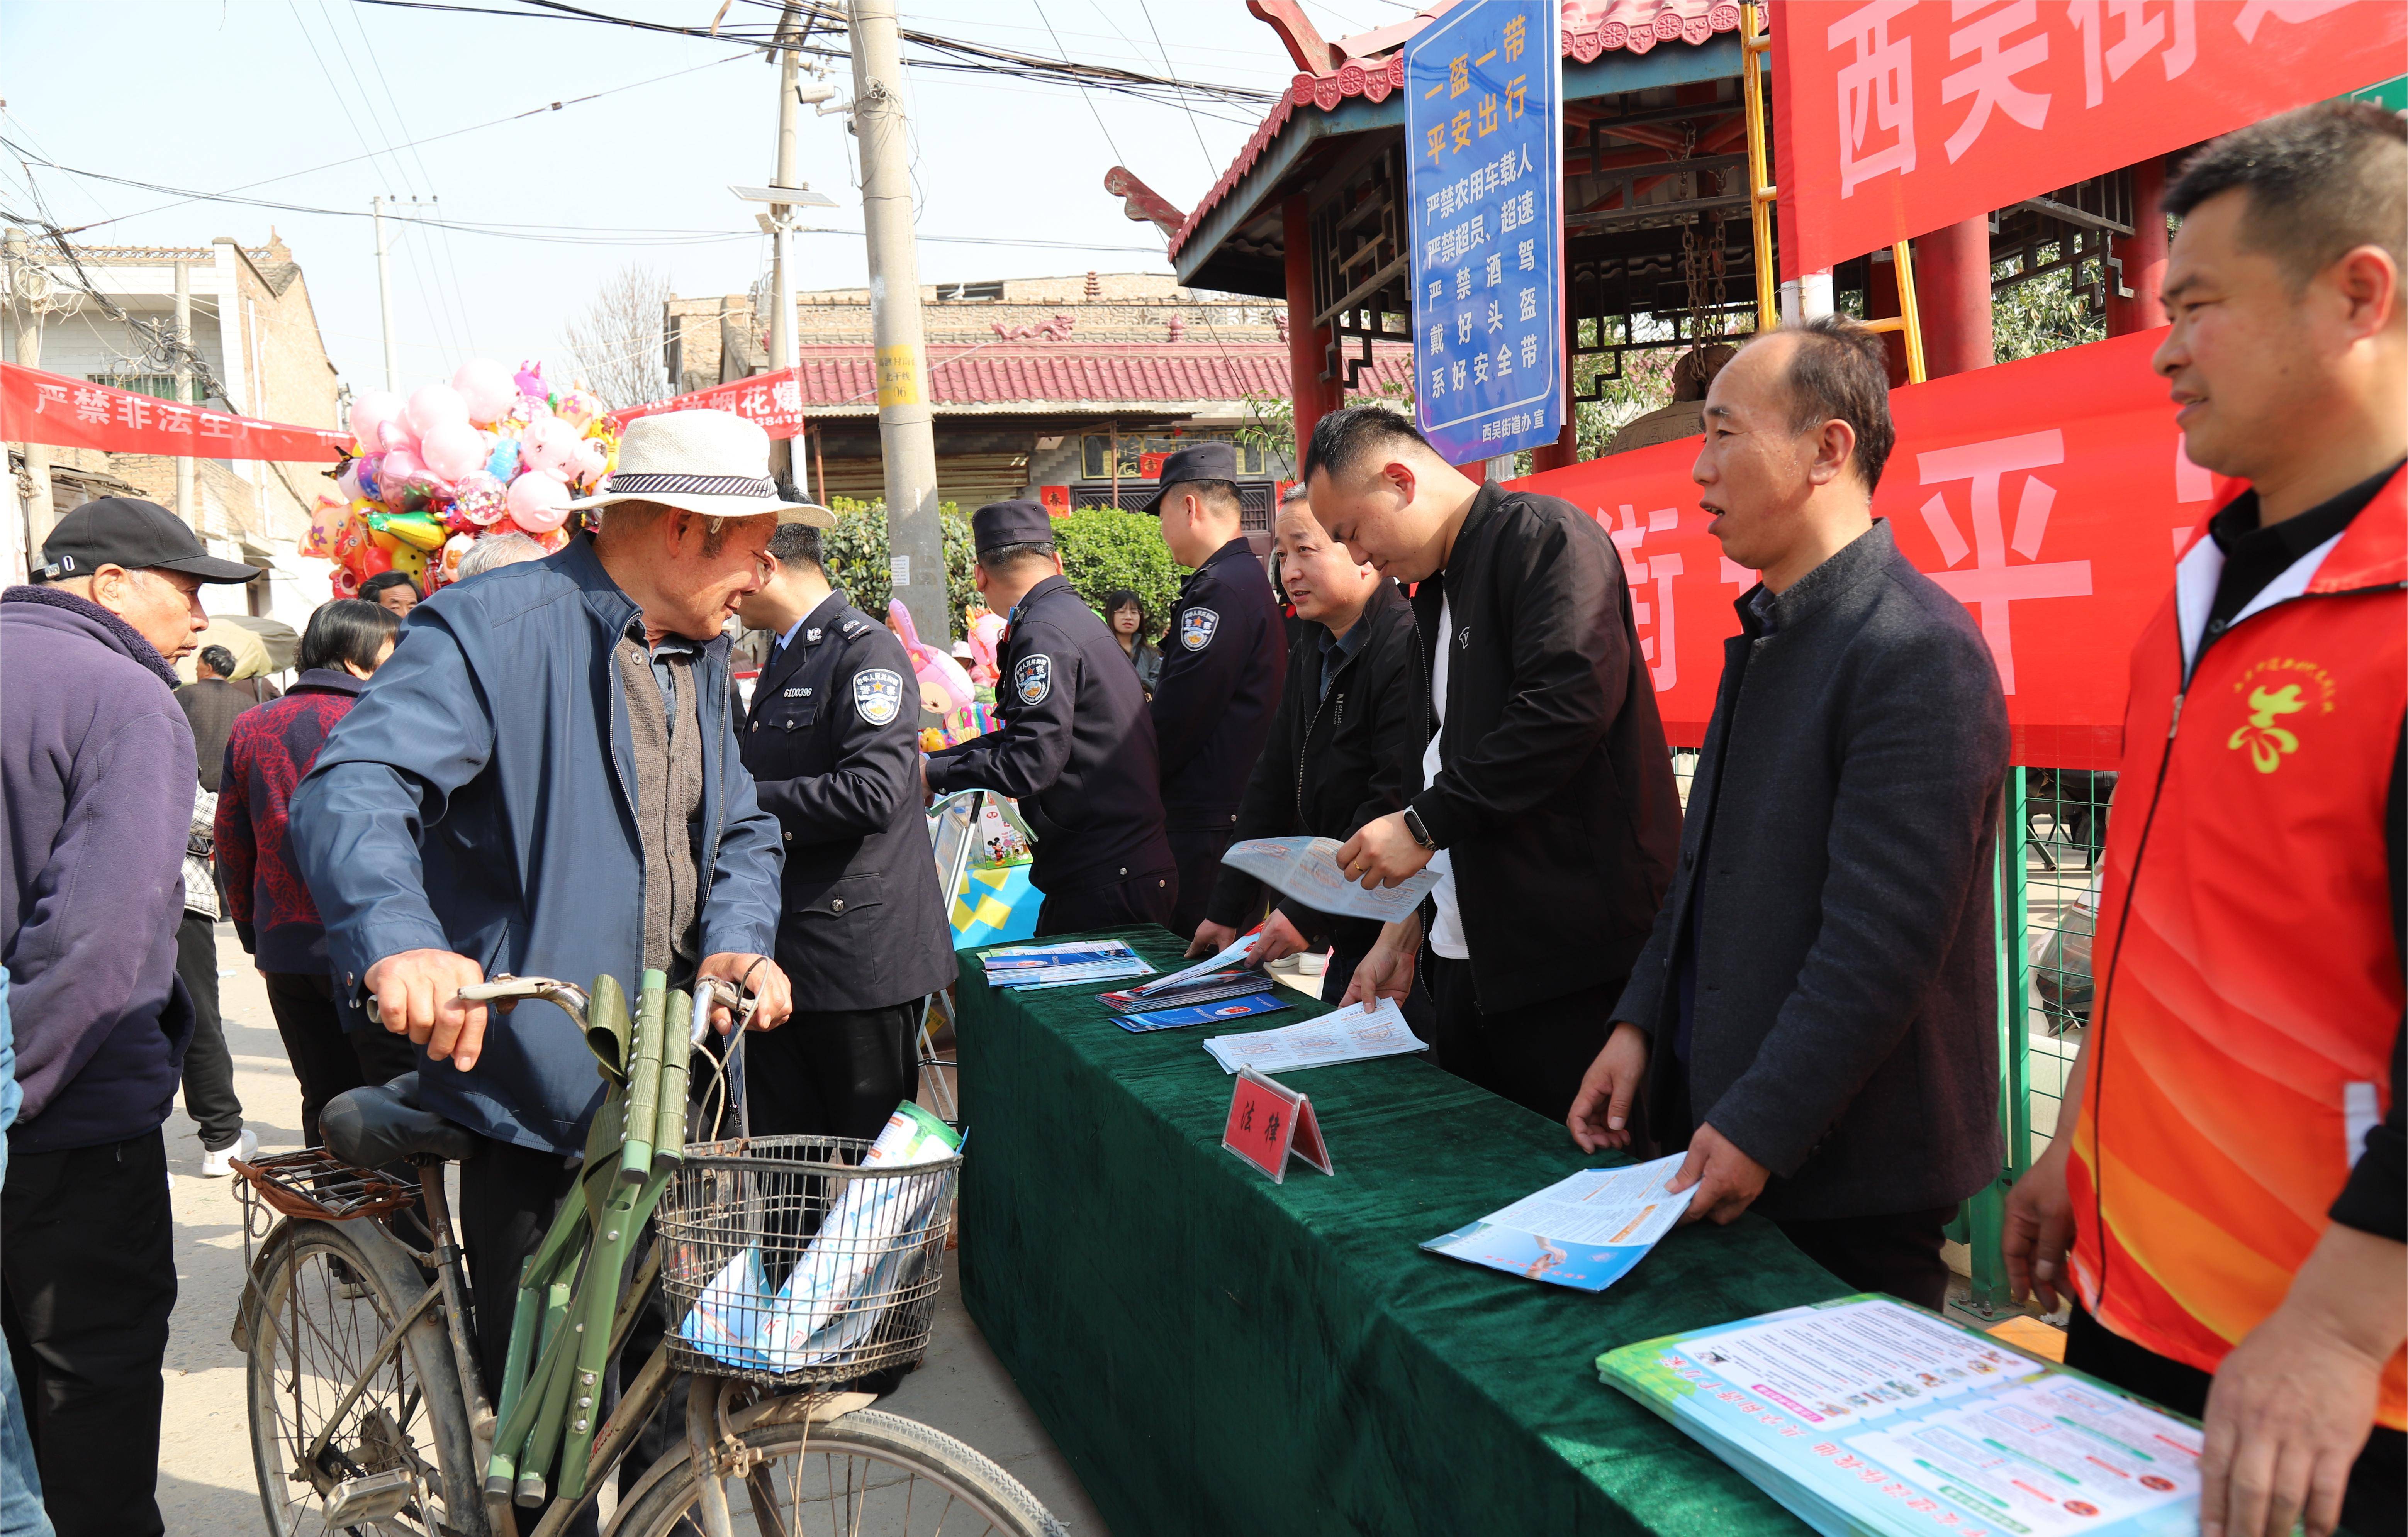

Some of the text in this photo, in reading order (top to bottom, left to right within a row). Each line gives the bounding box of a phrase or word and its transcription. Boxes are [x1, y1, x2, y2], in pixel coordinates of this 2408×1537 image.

[1425, 14, 1526, 100] 一盔一带
[1427, 73, 1527, 165] 平安出行
[1827, 0, 2371, 199] 西吴街
[1426, 142, 1533, 226] 严禁农用车载人
[1427, 190, 1534, 270] 严禁超员、超速
[1429, 238, 1535, 313] 严禁酒驾
[1430, 286, 1537, 356] 戴好头盔
[885, 372, 911, 382] 北干线
[894, 386, 906, 397] 06
[1432, 333, 1537, 398] 系好安全带
[1482, 408, 1544, 442] 西吴街道办 宣
[856, 673, 899, 686] 中华人民共和国
[860, 685, 896, 696] 警察
[1240, 1100, 1280, 1152] 法律
